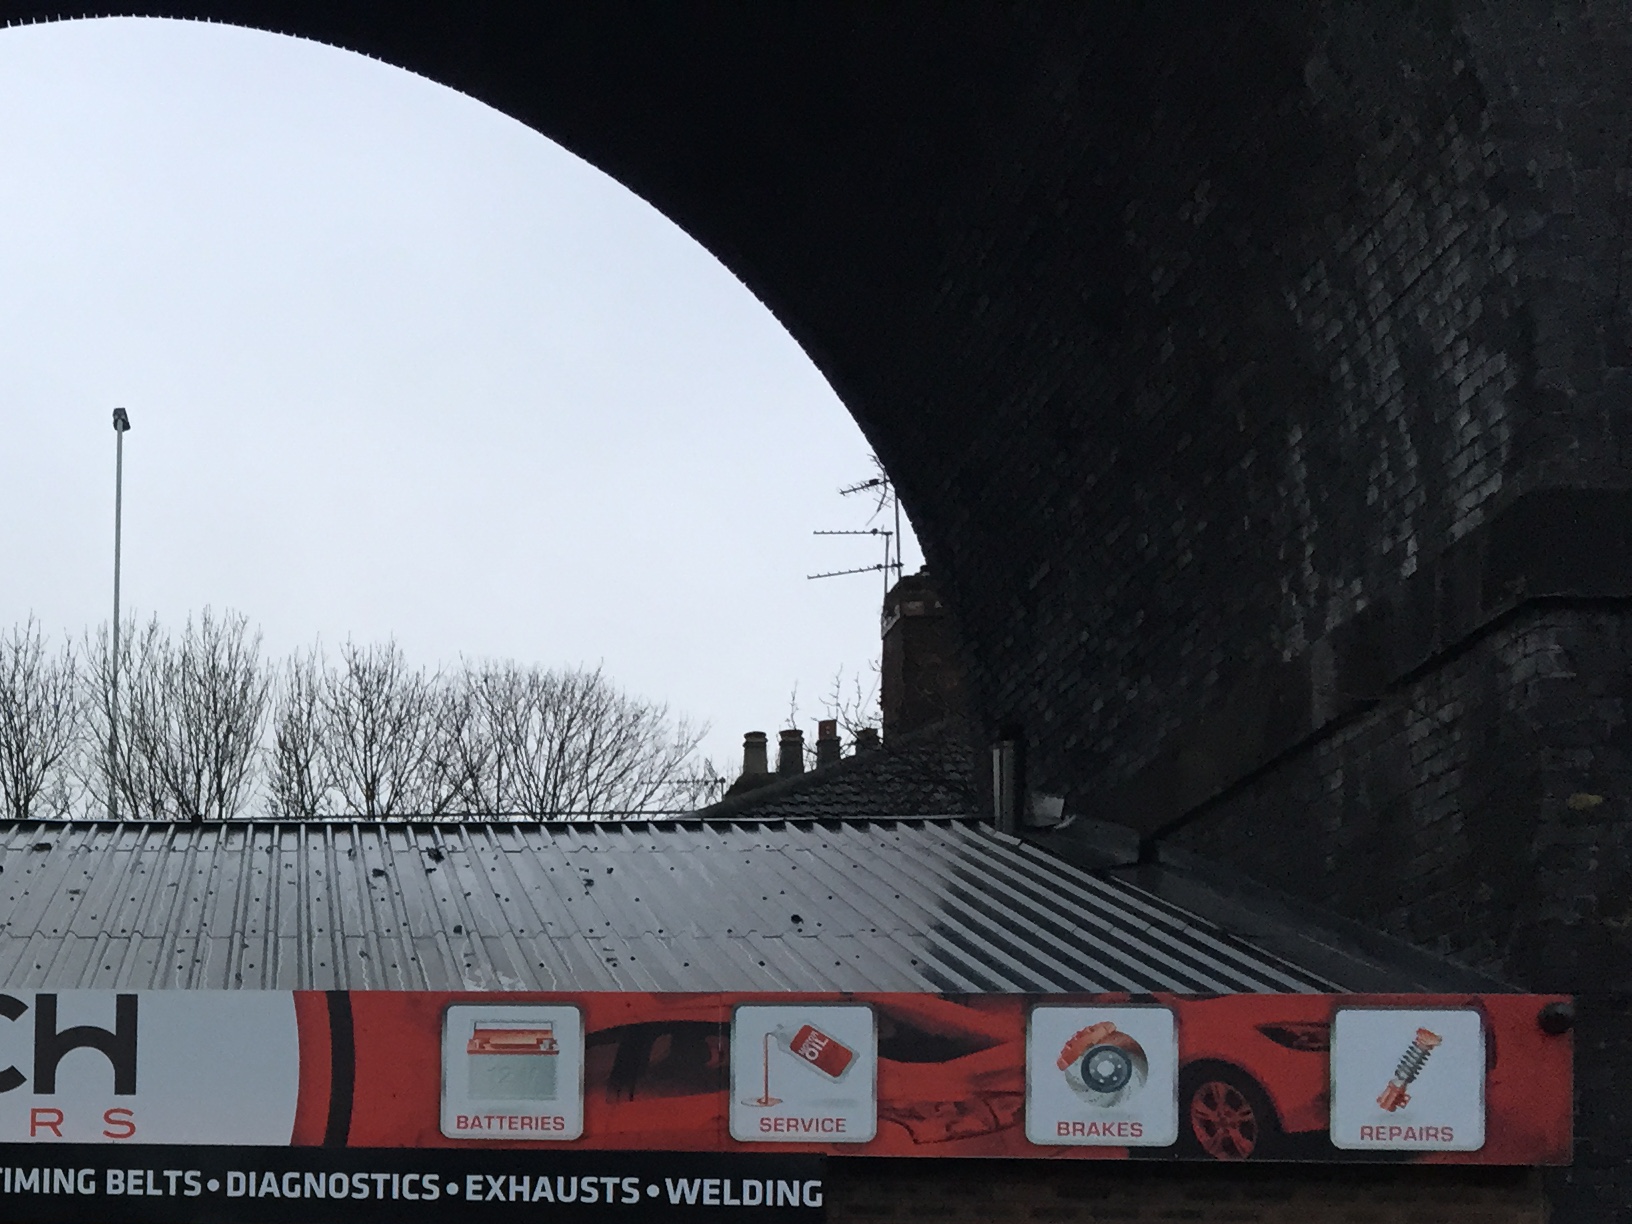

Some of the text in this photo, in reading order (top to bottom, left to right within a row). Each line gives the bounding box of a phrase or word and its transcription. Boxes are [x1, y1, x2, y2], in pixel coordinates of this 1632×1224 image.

[805, 1038, 829, 1061] OIL
[455, 1114, 566, 1132] BATTERIES
[758, 1116, 847, 1134] SERVICE
[1056, 1121, 1144, 1139] BRAKES
[1359, 1124, 1455, 1144] REPAIRS
[106, 1168, 203, 1198] BELTS
[226, 1170, 441, 1202] DIAGNOSTICS
[465, 1174, 640, 1205] EXHAUSTS
[664, 1177, 824, 1208] WELDING
